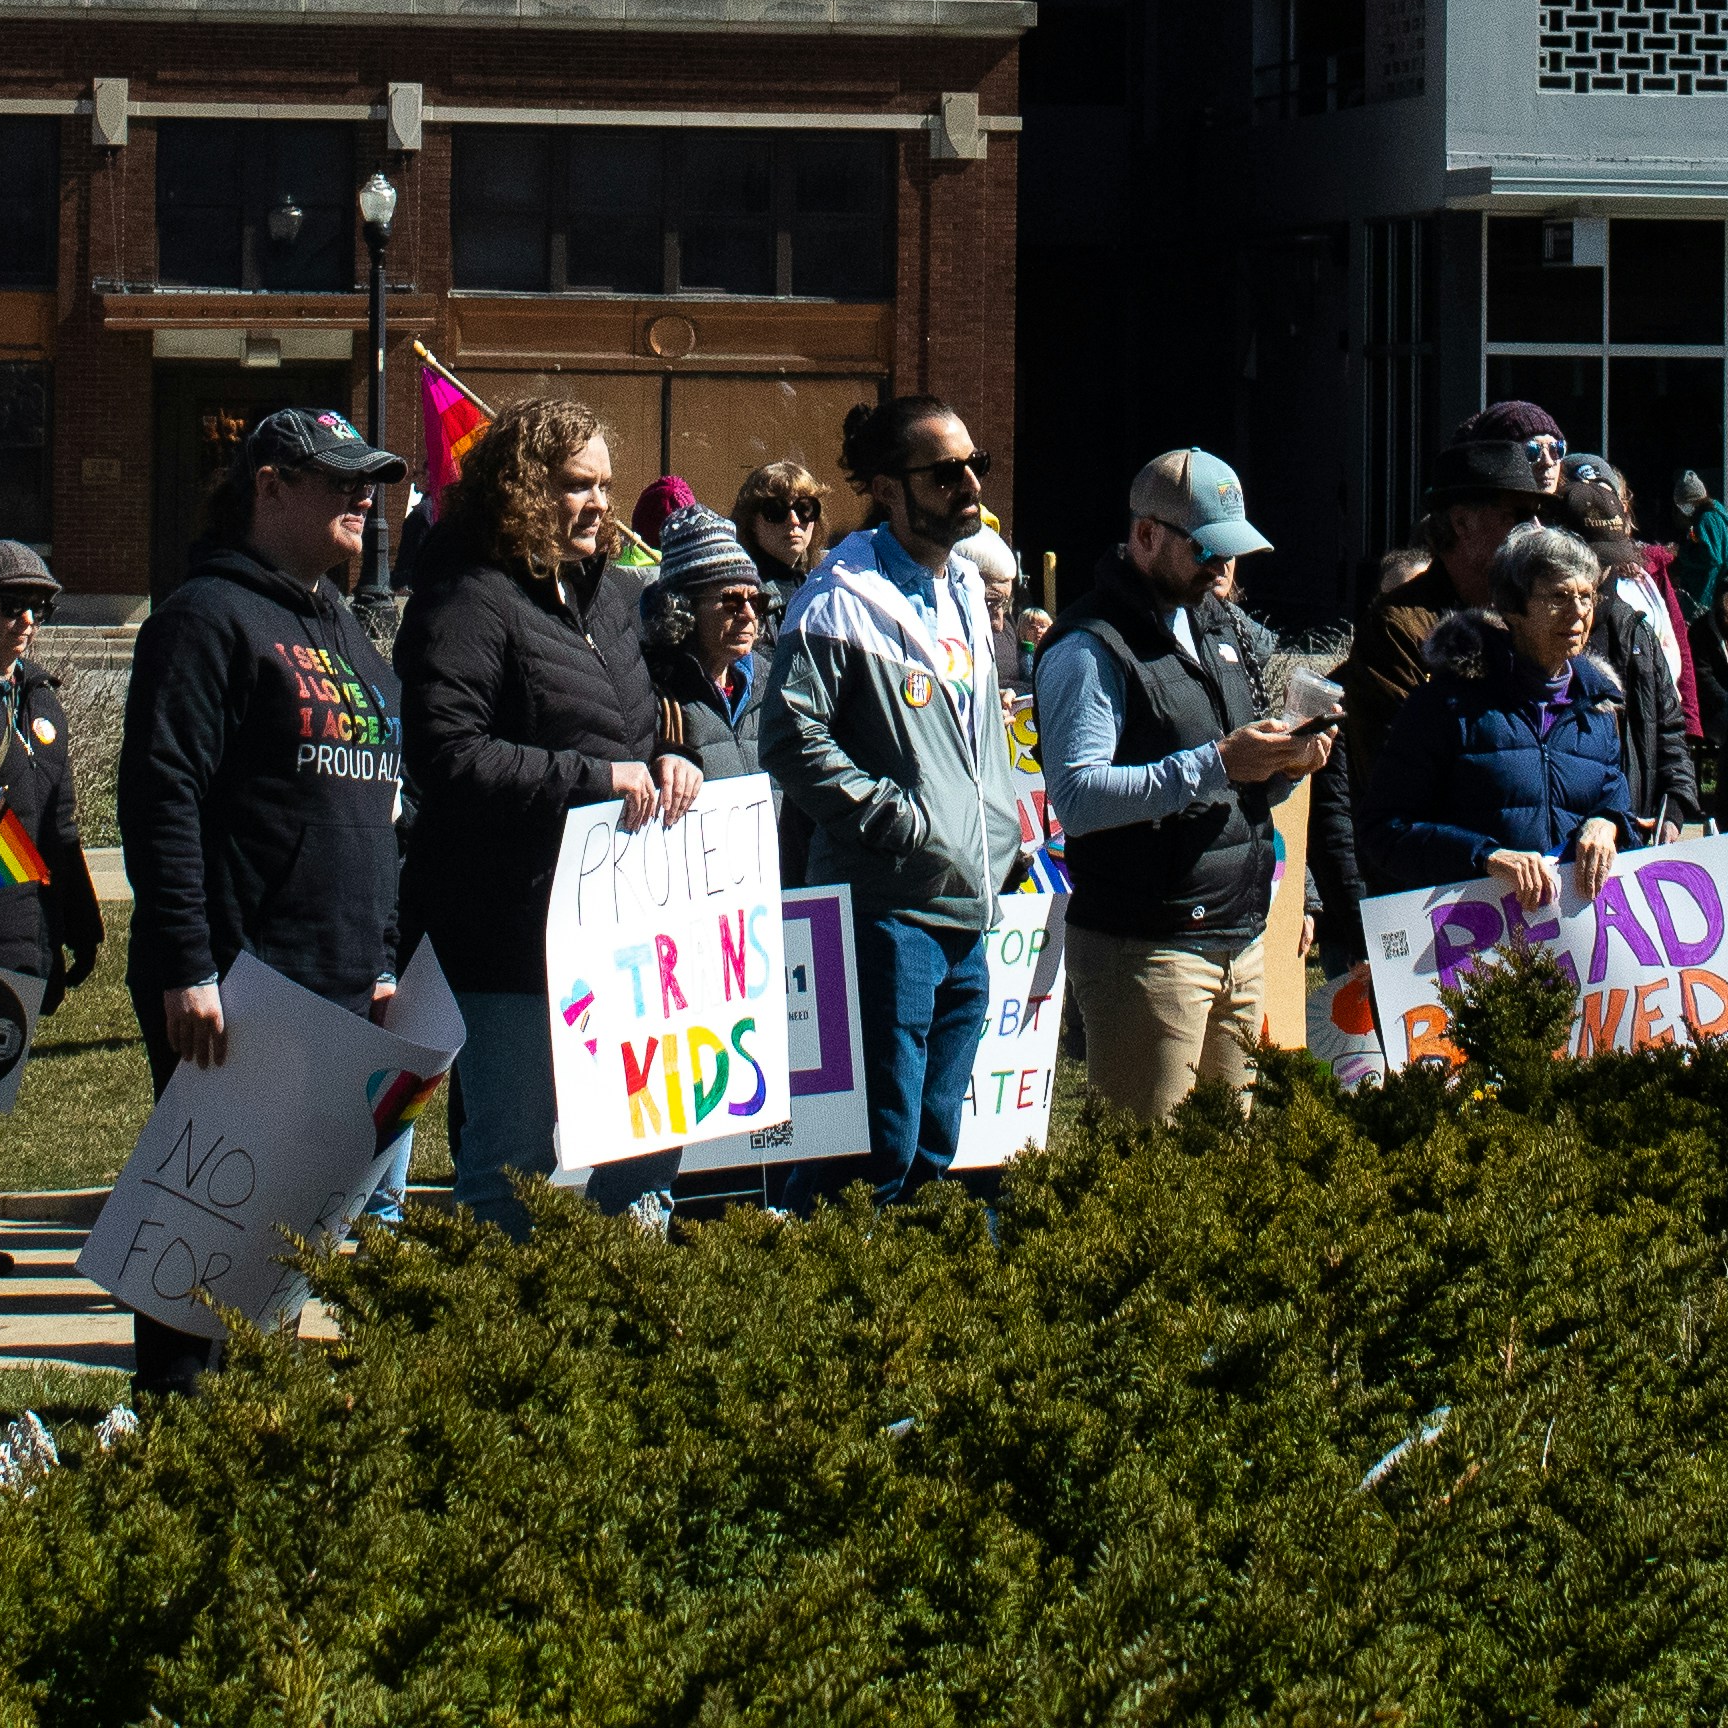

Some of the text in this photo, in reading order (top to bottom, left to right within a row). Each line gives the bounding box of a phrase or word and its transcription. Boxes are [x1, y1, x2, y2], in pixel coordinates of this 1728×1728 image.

[295, 671, 311, 699] I
[299, 707, 313, 738] I
[296, 743, 402, 782] PROUD ALL
[577, 799, 768, 927] PROTECT
[613, 904, 771, 1020] TRANS
[984, 927, 1050, 968] TOP
[1429, 859, 1725, 995] READ
[620, 1016, 767, 1140] KIDS
[963, 1069, 1051, 1116] ATE!
[156, 1118, 256, 1208] NO
[117, 1219, 233, 1307] FOR
